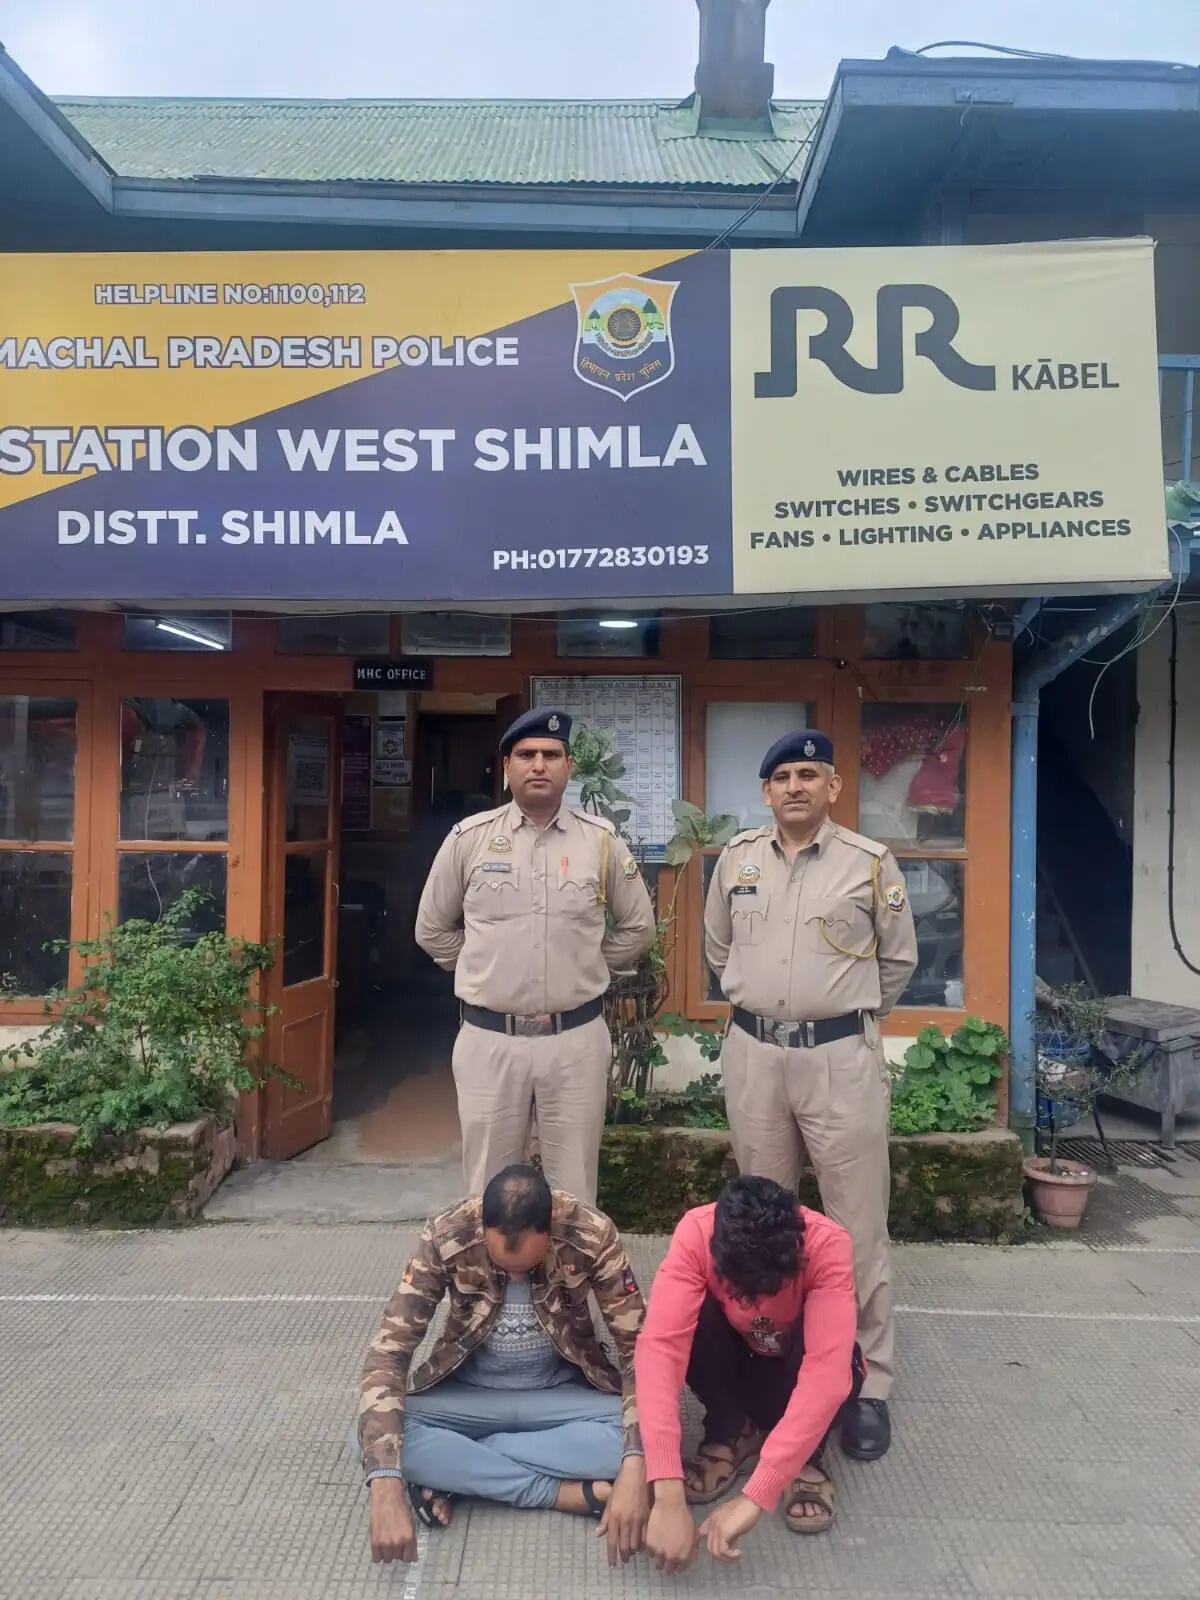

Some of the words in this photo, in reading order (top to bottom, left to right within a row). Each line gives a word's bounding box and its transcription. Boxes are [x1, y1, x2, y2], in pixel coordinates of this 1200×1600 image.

[95, 284, 218, 304] HELPLINE
[224, 283, 365, 306] NO:1100,112
[169, 337, 361, 369] PRADESH
[373, 335, 520, 368] POLICE
[754, 284, 996, 398] RR
[1012, 358, 1120, 390] KĀBEL
[0, 427, 259, 474] STATION
[277, 429, 456, 472] WEST
[474, 424, 707, 471] SHIMLA
[837, 468, 916, 488] WIRES
[922, 467, 938, 484] &
[945, 463, 1039, 483] CABLES
[774, 498, 900, 519] SWITCHES
[925, 490, 1104, 512] SWITCHGEARS
[58, 510, 207, 545] DISTT.
[221, 510, 409, 545] SHIMLA
[750, 530, 815, 550] FANS
[839, 524, 953, 546] LIGHTING
[977, 519, 1132, 541] APPLIANCES
[493, 545, 709, 570] PH:01772830193
[387, 668, 426, 680] OFFICE
